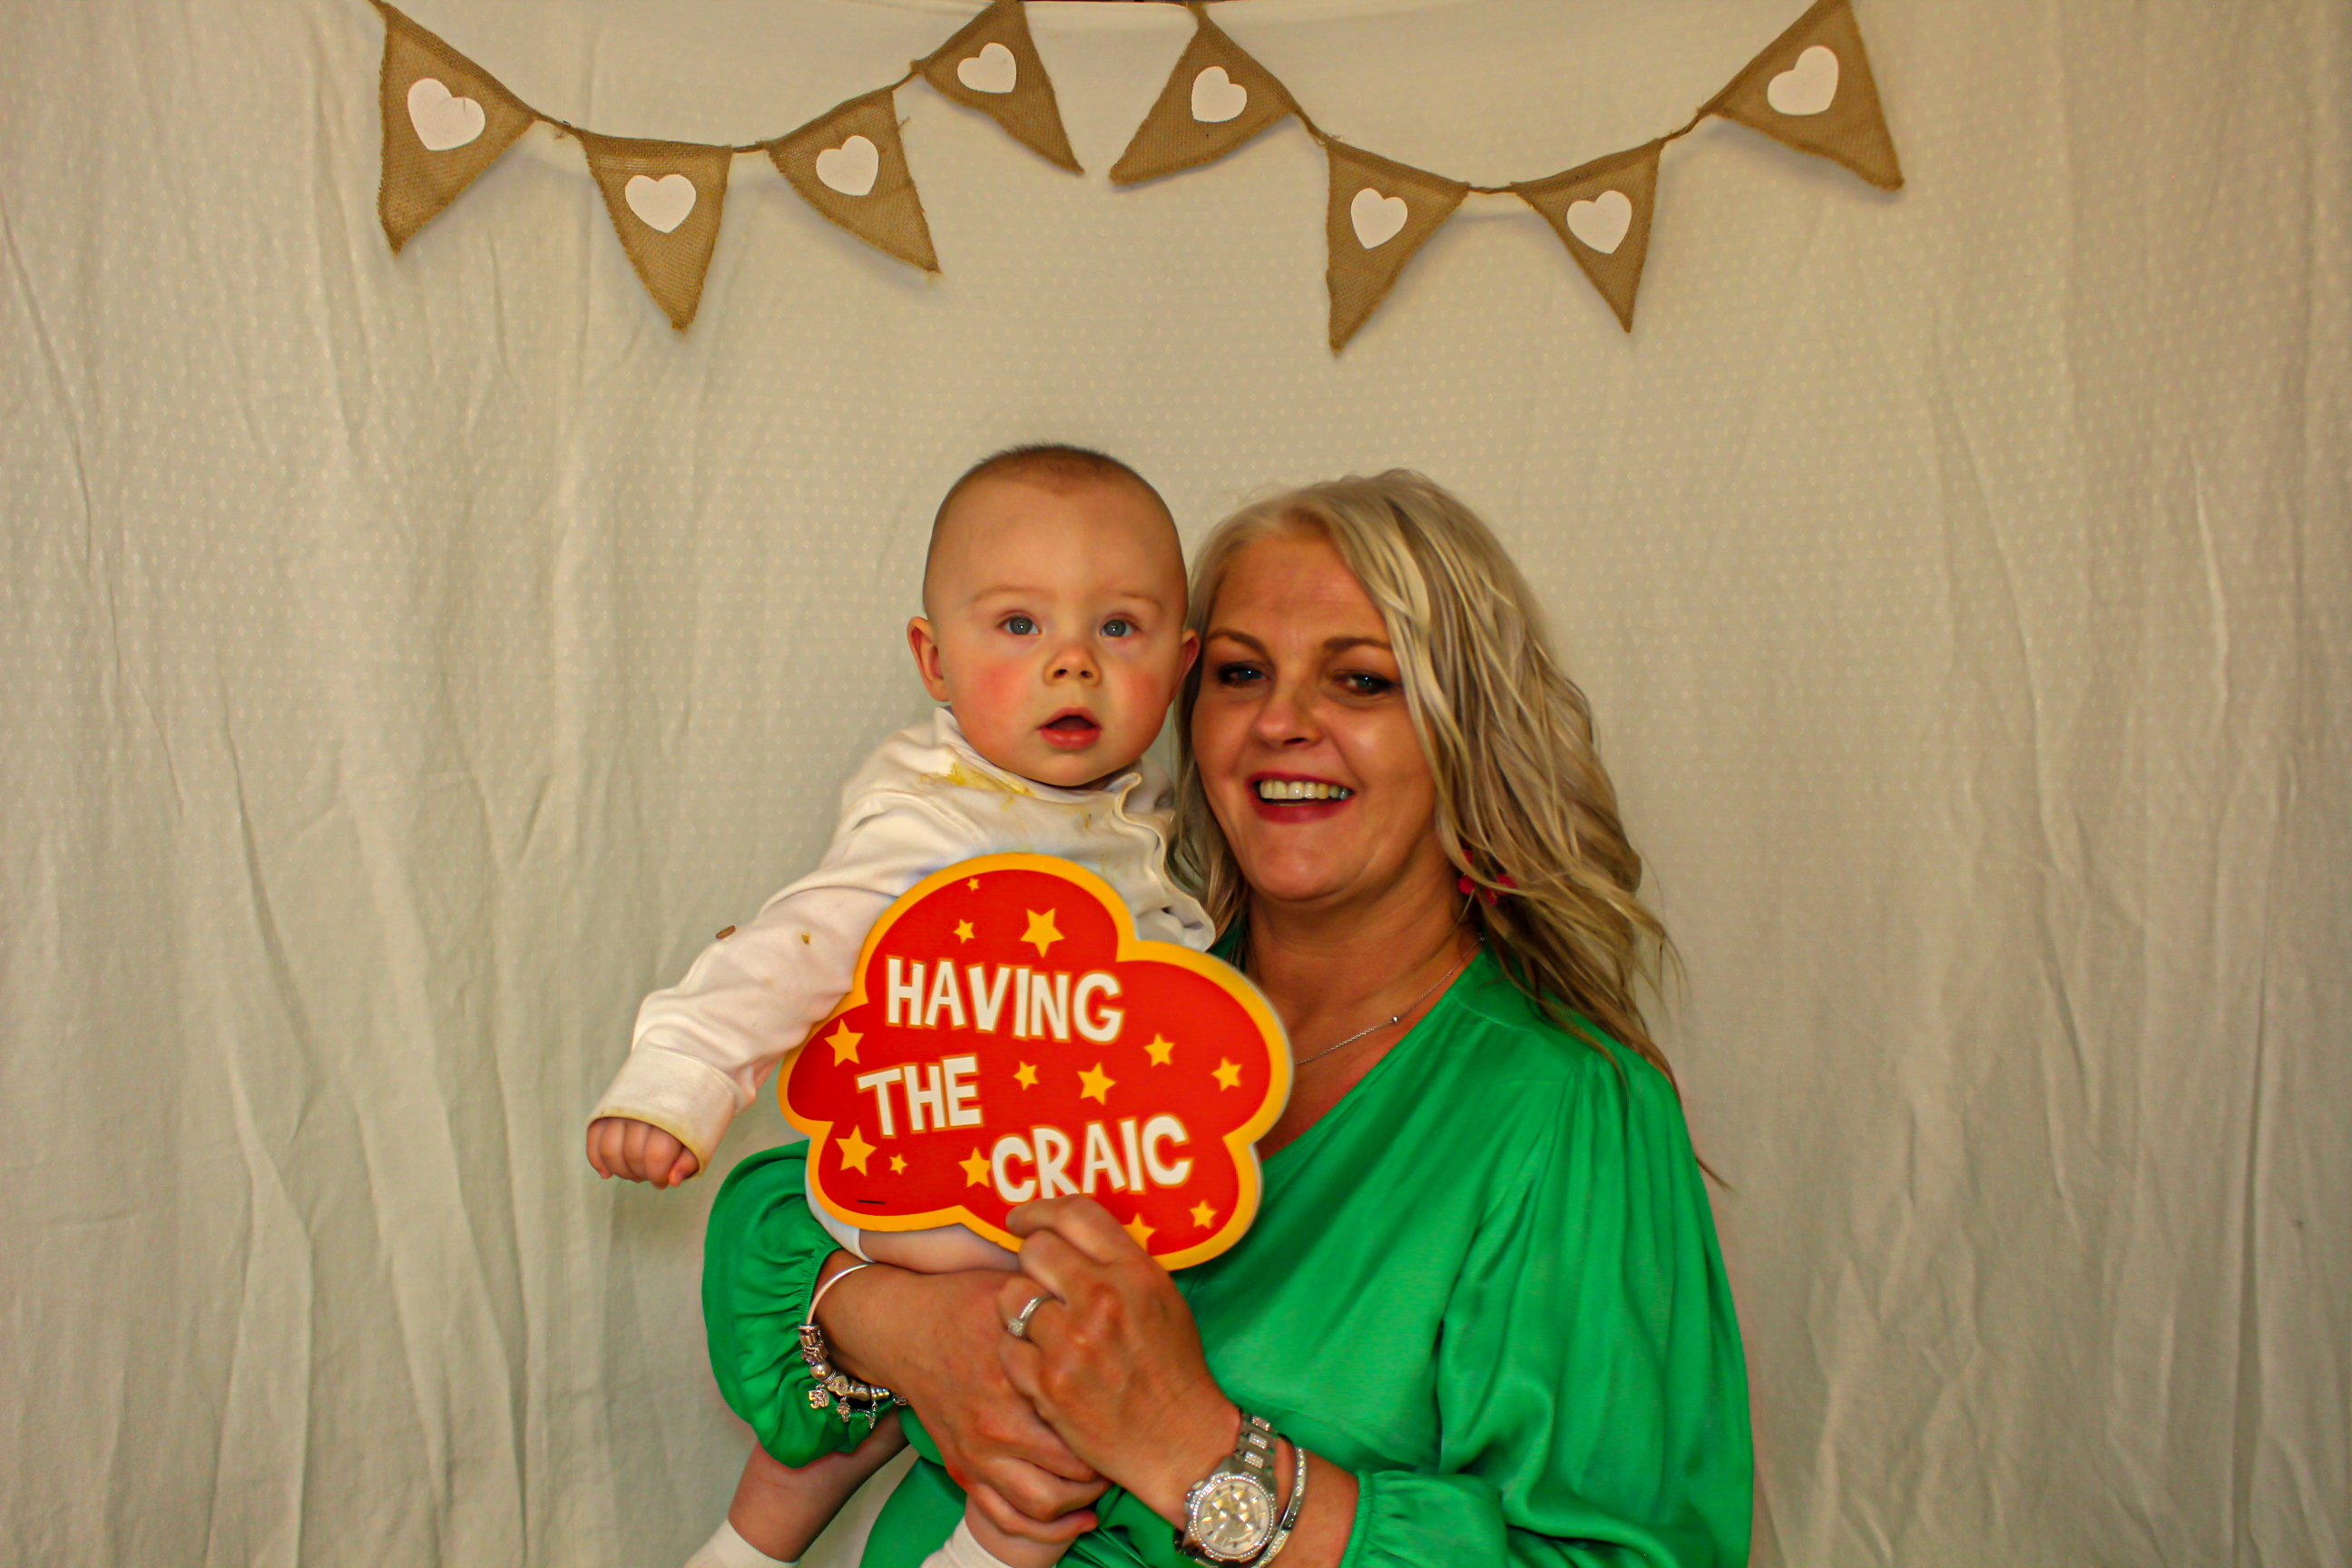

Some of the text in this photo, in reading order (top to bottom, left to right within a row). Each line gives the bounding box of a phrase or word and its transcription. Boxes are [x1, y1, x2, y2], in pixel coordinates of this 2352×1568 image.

[887, 957, 1122, 1043] HAVING
[857, 1055, 982, 1136] THE
[991, 1115, 1191, 1202] CRAIC
